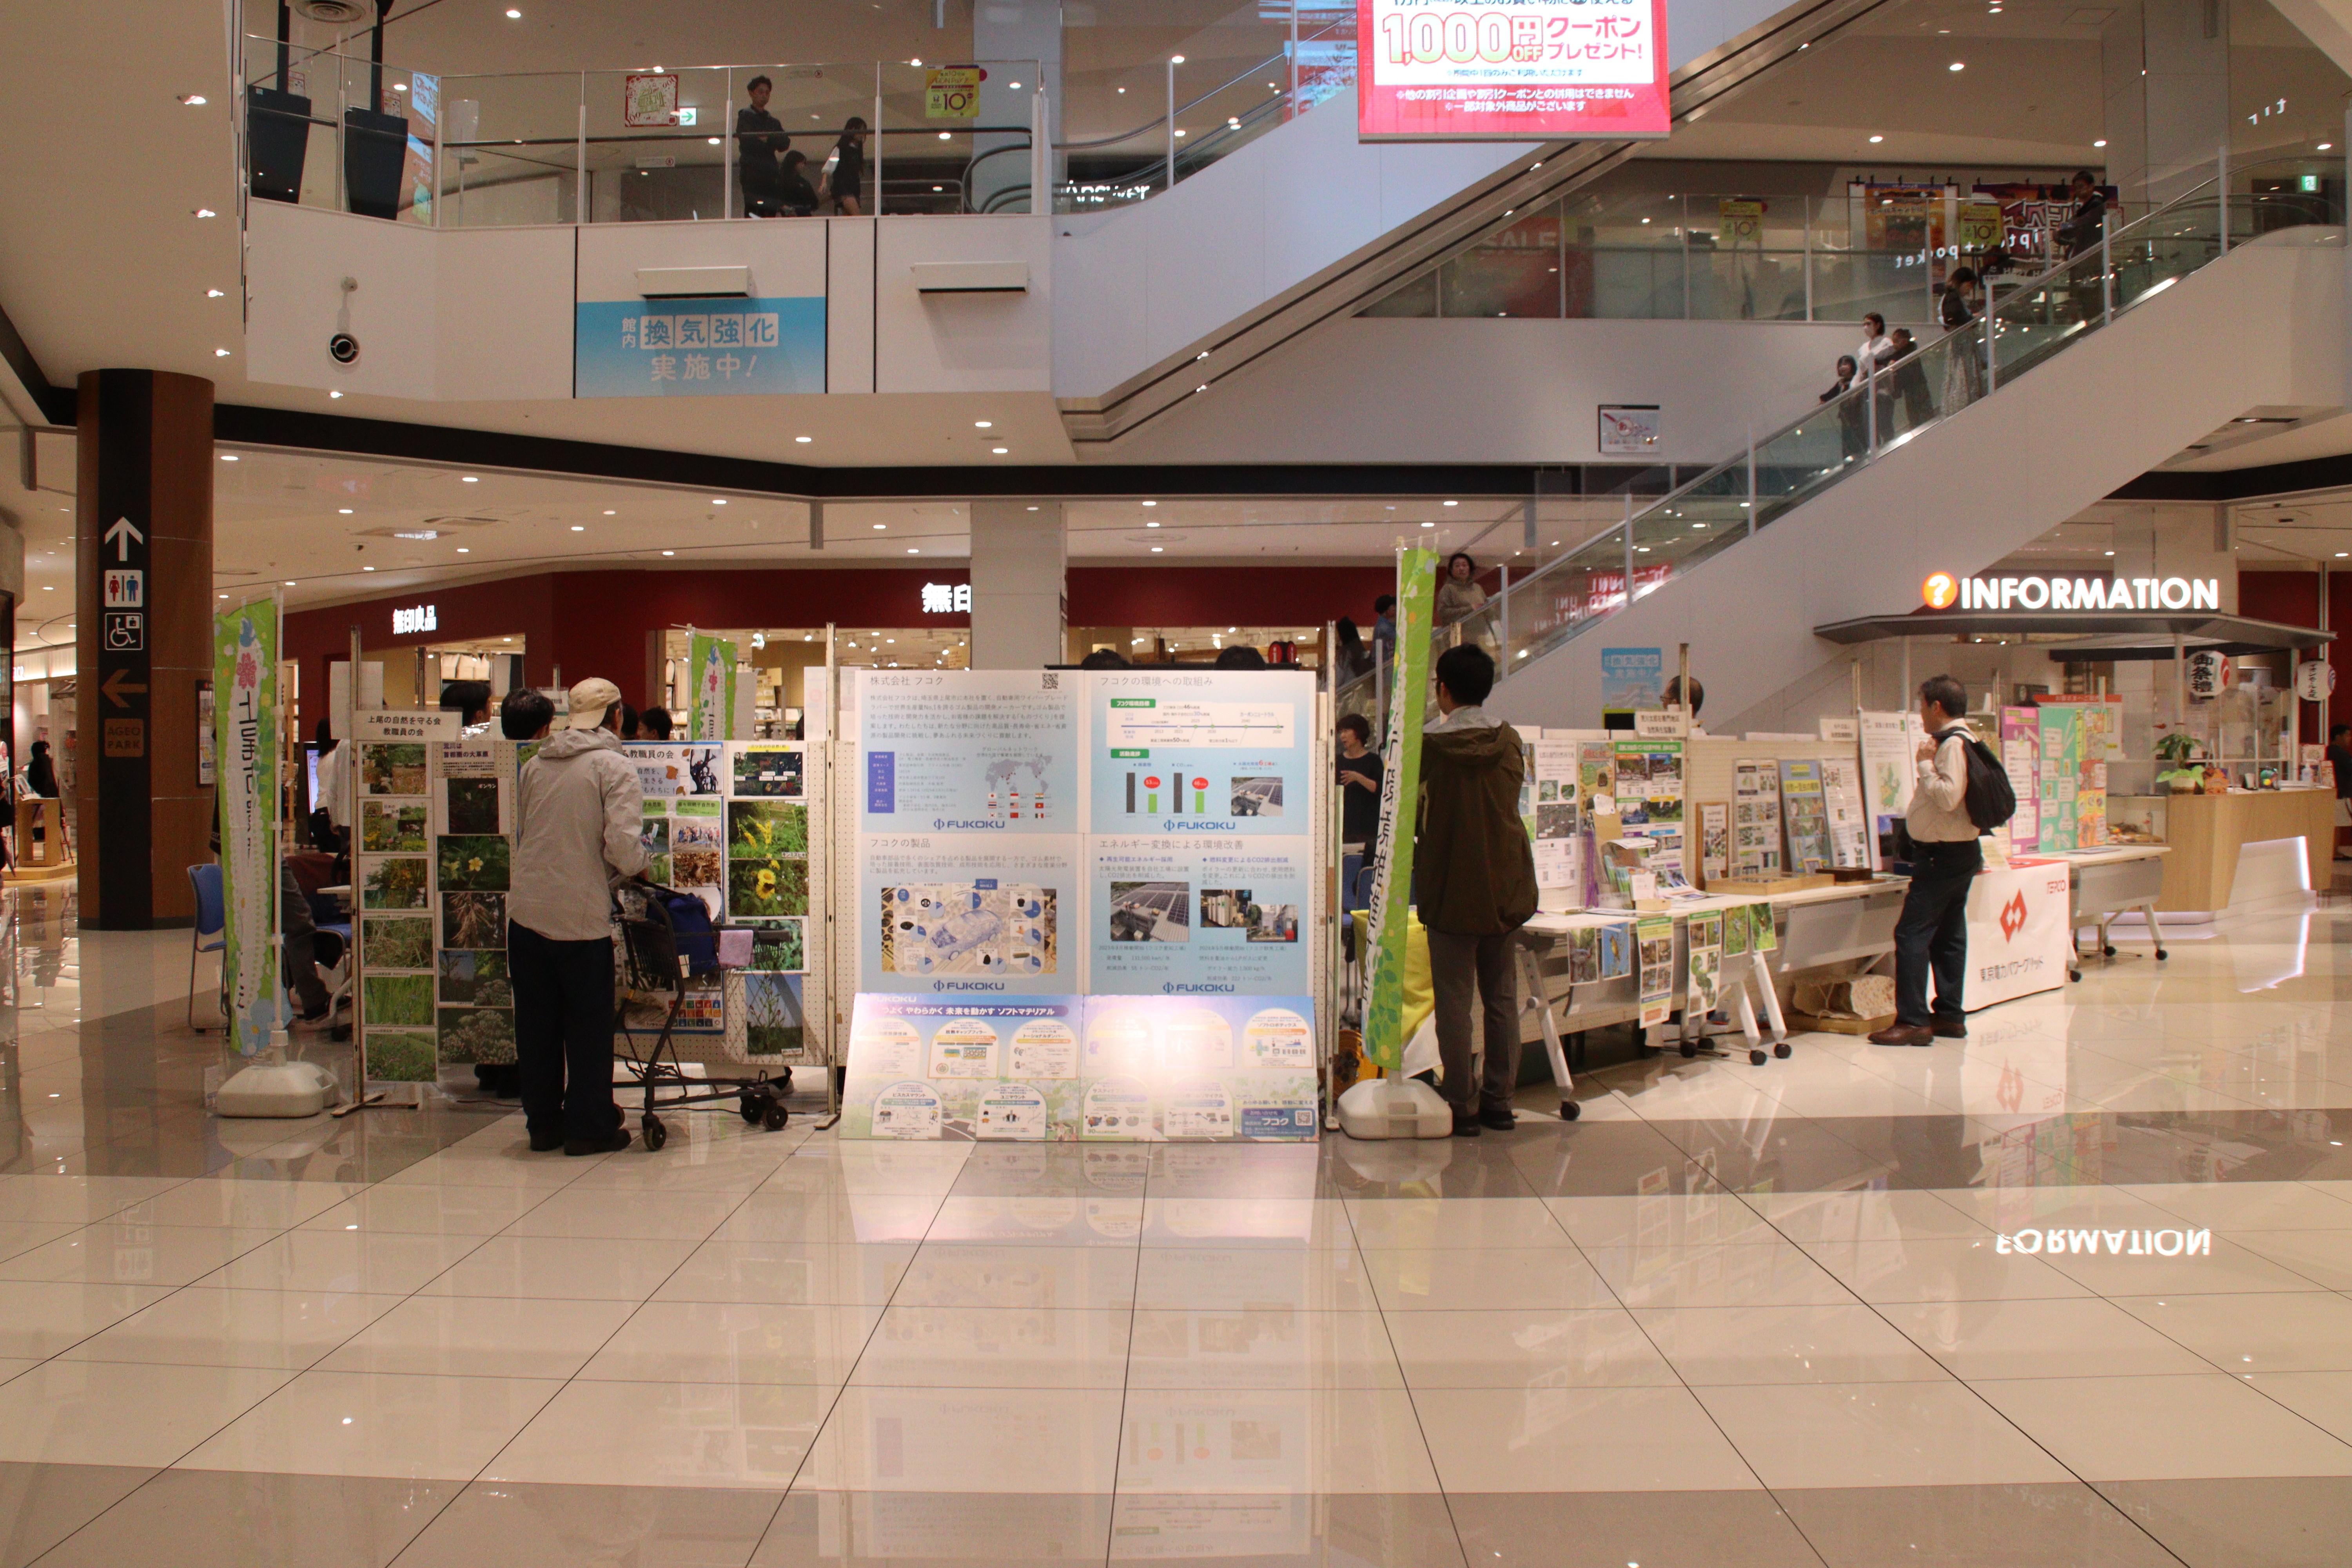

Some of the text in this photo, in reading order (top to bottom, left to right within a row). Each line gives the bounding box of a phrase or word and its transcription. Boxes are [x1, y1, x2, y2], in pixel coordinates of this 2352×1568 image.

[1547, 15, 1641, 38] クーポン
[1513, 45, 1543, 61] OFF
[642, 317, 777, 345] 換気強化
[651, 353, 758, 380] 実施中!
[1961, 577, 2219, 609] INFORMATION
[393, 605, 437, 635] 無印良品
[870, 676, 944, 686] 株式会社 フコク
[1100, 677, 1213, 686] フコクの環境への取組み
[368, 716, 441, 725] 上尾の自然を守る会
[107, 727, 140, 735] AGEO
[107, 740, 140, 749] PARK
[947, 820, 1005, 829] FUKOKU
[870, 839, 931, 848] フコクの製品
[1099, 840, 1244, 850] エネルギー変換による環境改善
[2046, 880, 2066, 895] TEPCO
[1980, 956, 2044, 983] 東京電力パワーグリッド
[1177, 984, 1234, 993] FUKOKU
